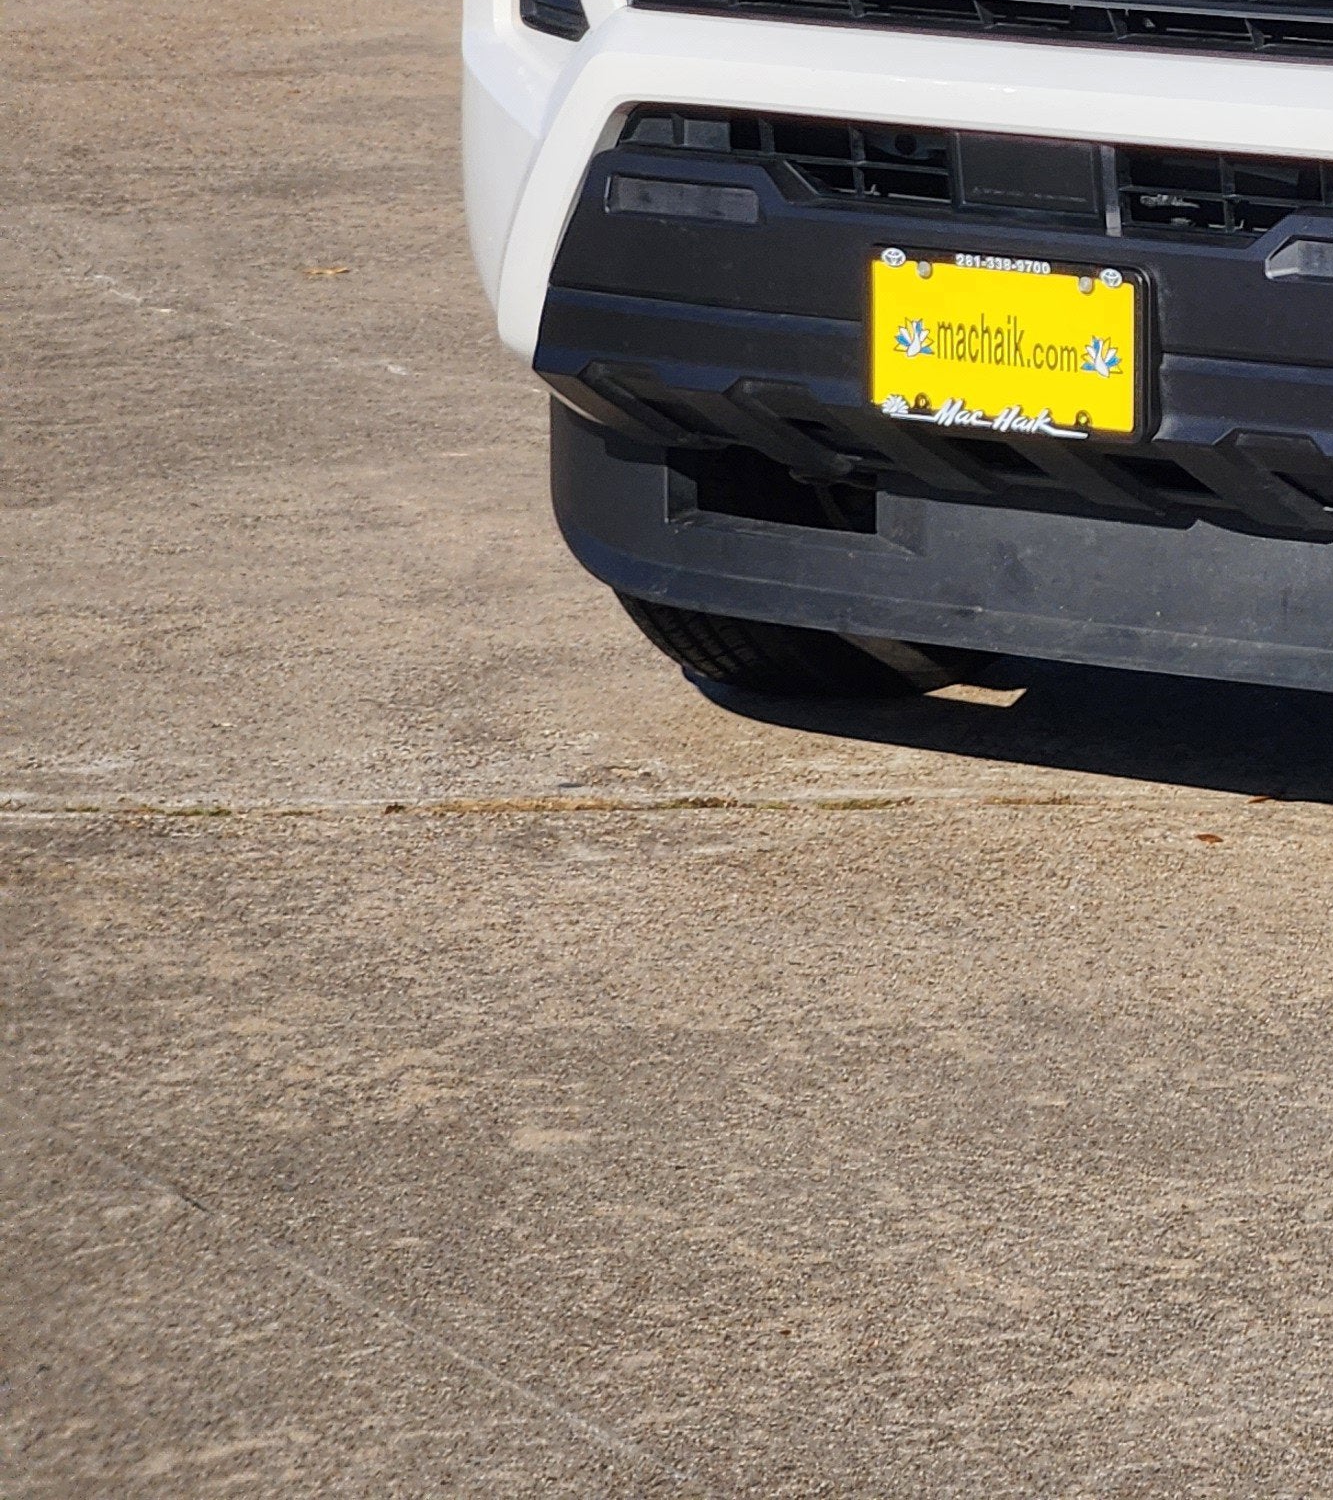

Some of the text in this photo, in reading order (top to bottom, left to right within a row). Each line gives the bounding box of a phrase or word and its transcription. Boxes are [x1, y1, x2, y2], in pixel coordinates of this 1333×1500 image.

[955, 253, 1051, 274] 281-338-9700
[937, 313, 1078, 373] machaik.com
[934, 398, 1065, 436] Mac Haik
